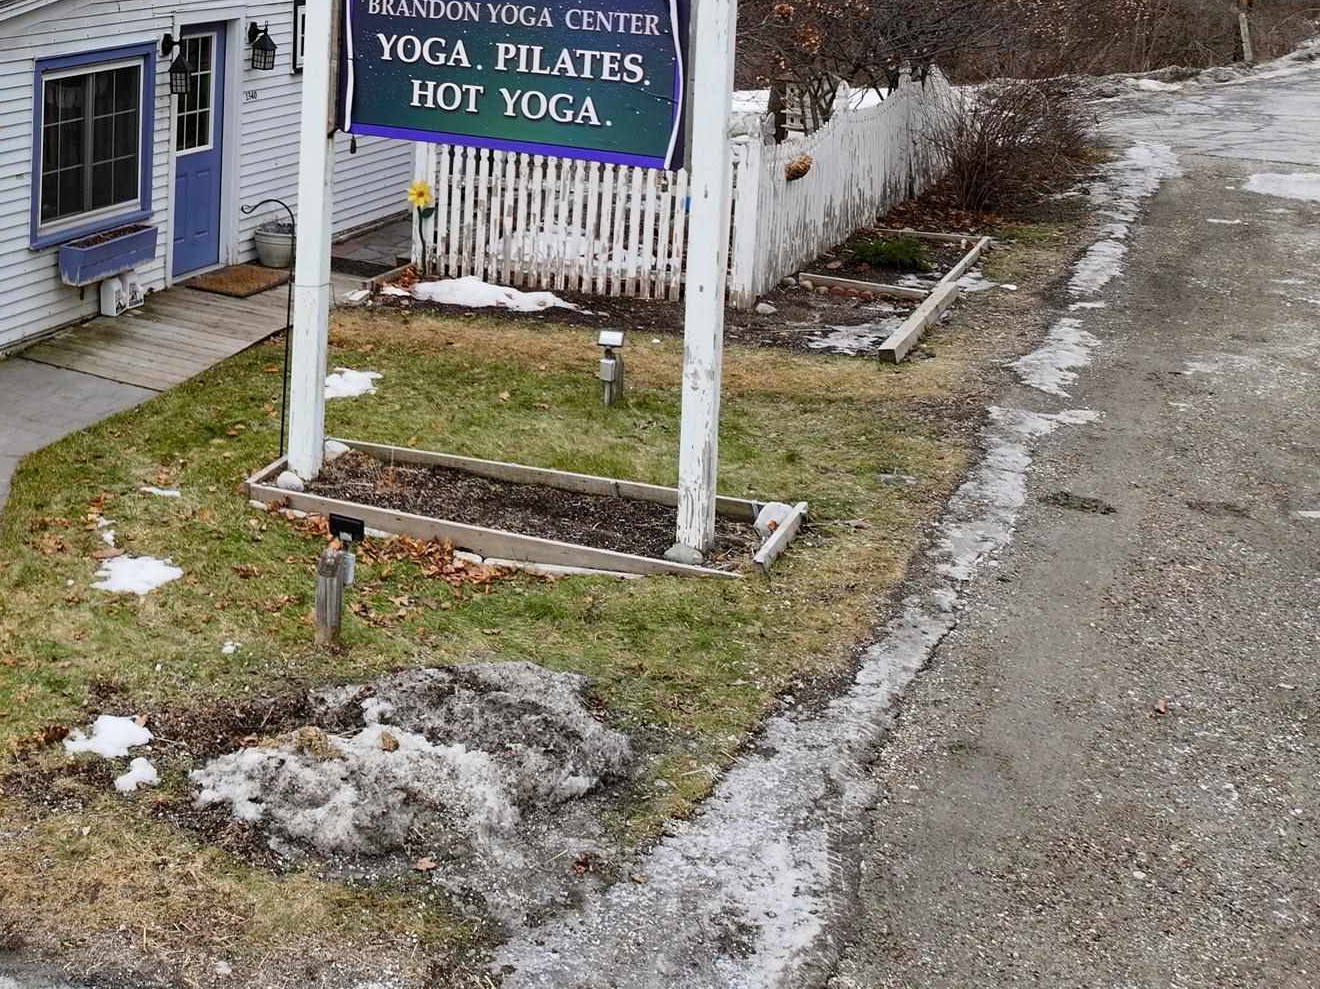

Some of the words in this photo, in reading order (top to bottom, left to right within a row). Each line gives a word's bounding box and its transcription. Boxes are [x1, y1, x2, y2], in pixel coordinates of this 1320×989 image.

[486, 1, 554, 30] YOGA
[565, 8, 661, 36] CENTER
[410, 79, 485, 113] HOT
